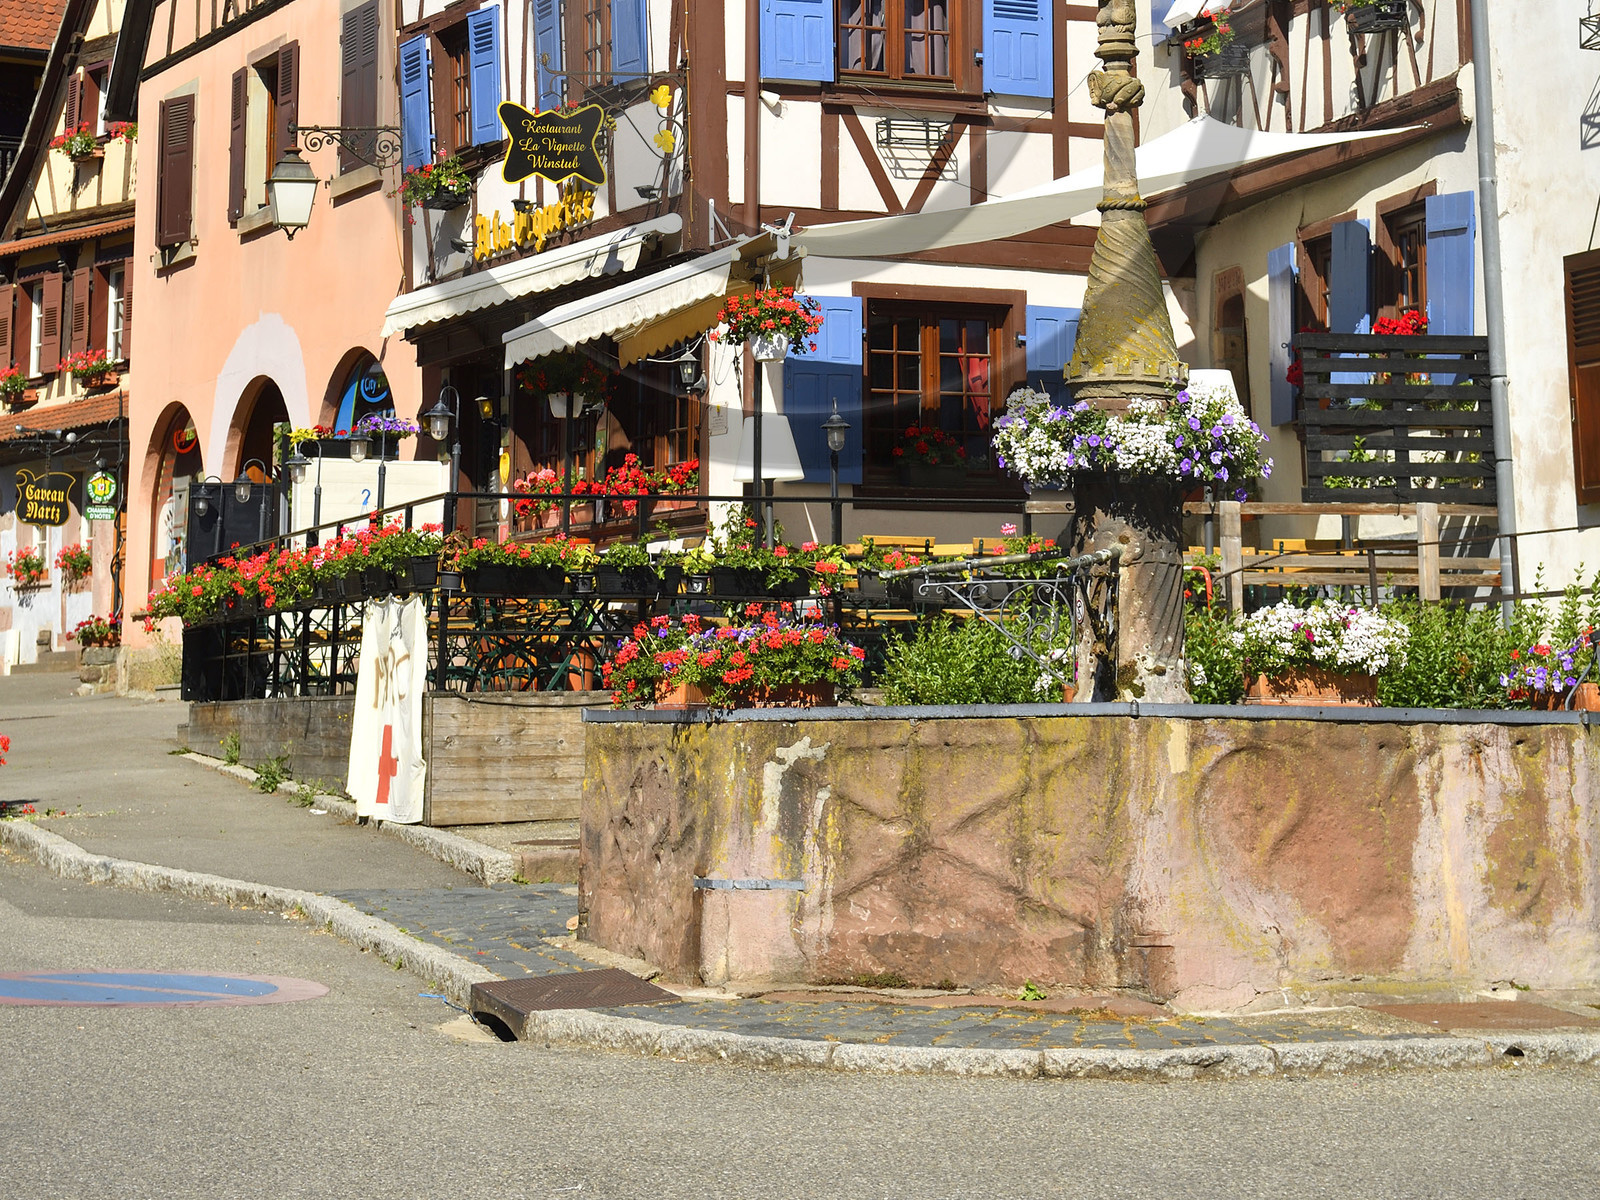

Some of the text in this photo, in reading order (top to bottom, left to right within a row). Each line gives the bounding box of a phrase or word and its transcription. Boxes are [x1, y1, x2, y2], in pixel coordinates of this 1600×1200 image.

[521, 118, 583, 134] Restaurant
[518, 136, 587, 156] La Vignette
[527, 153, 581, 169] Winstub
[26, 484, 64, 503] Caveau
